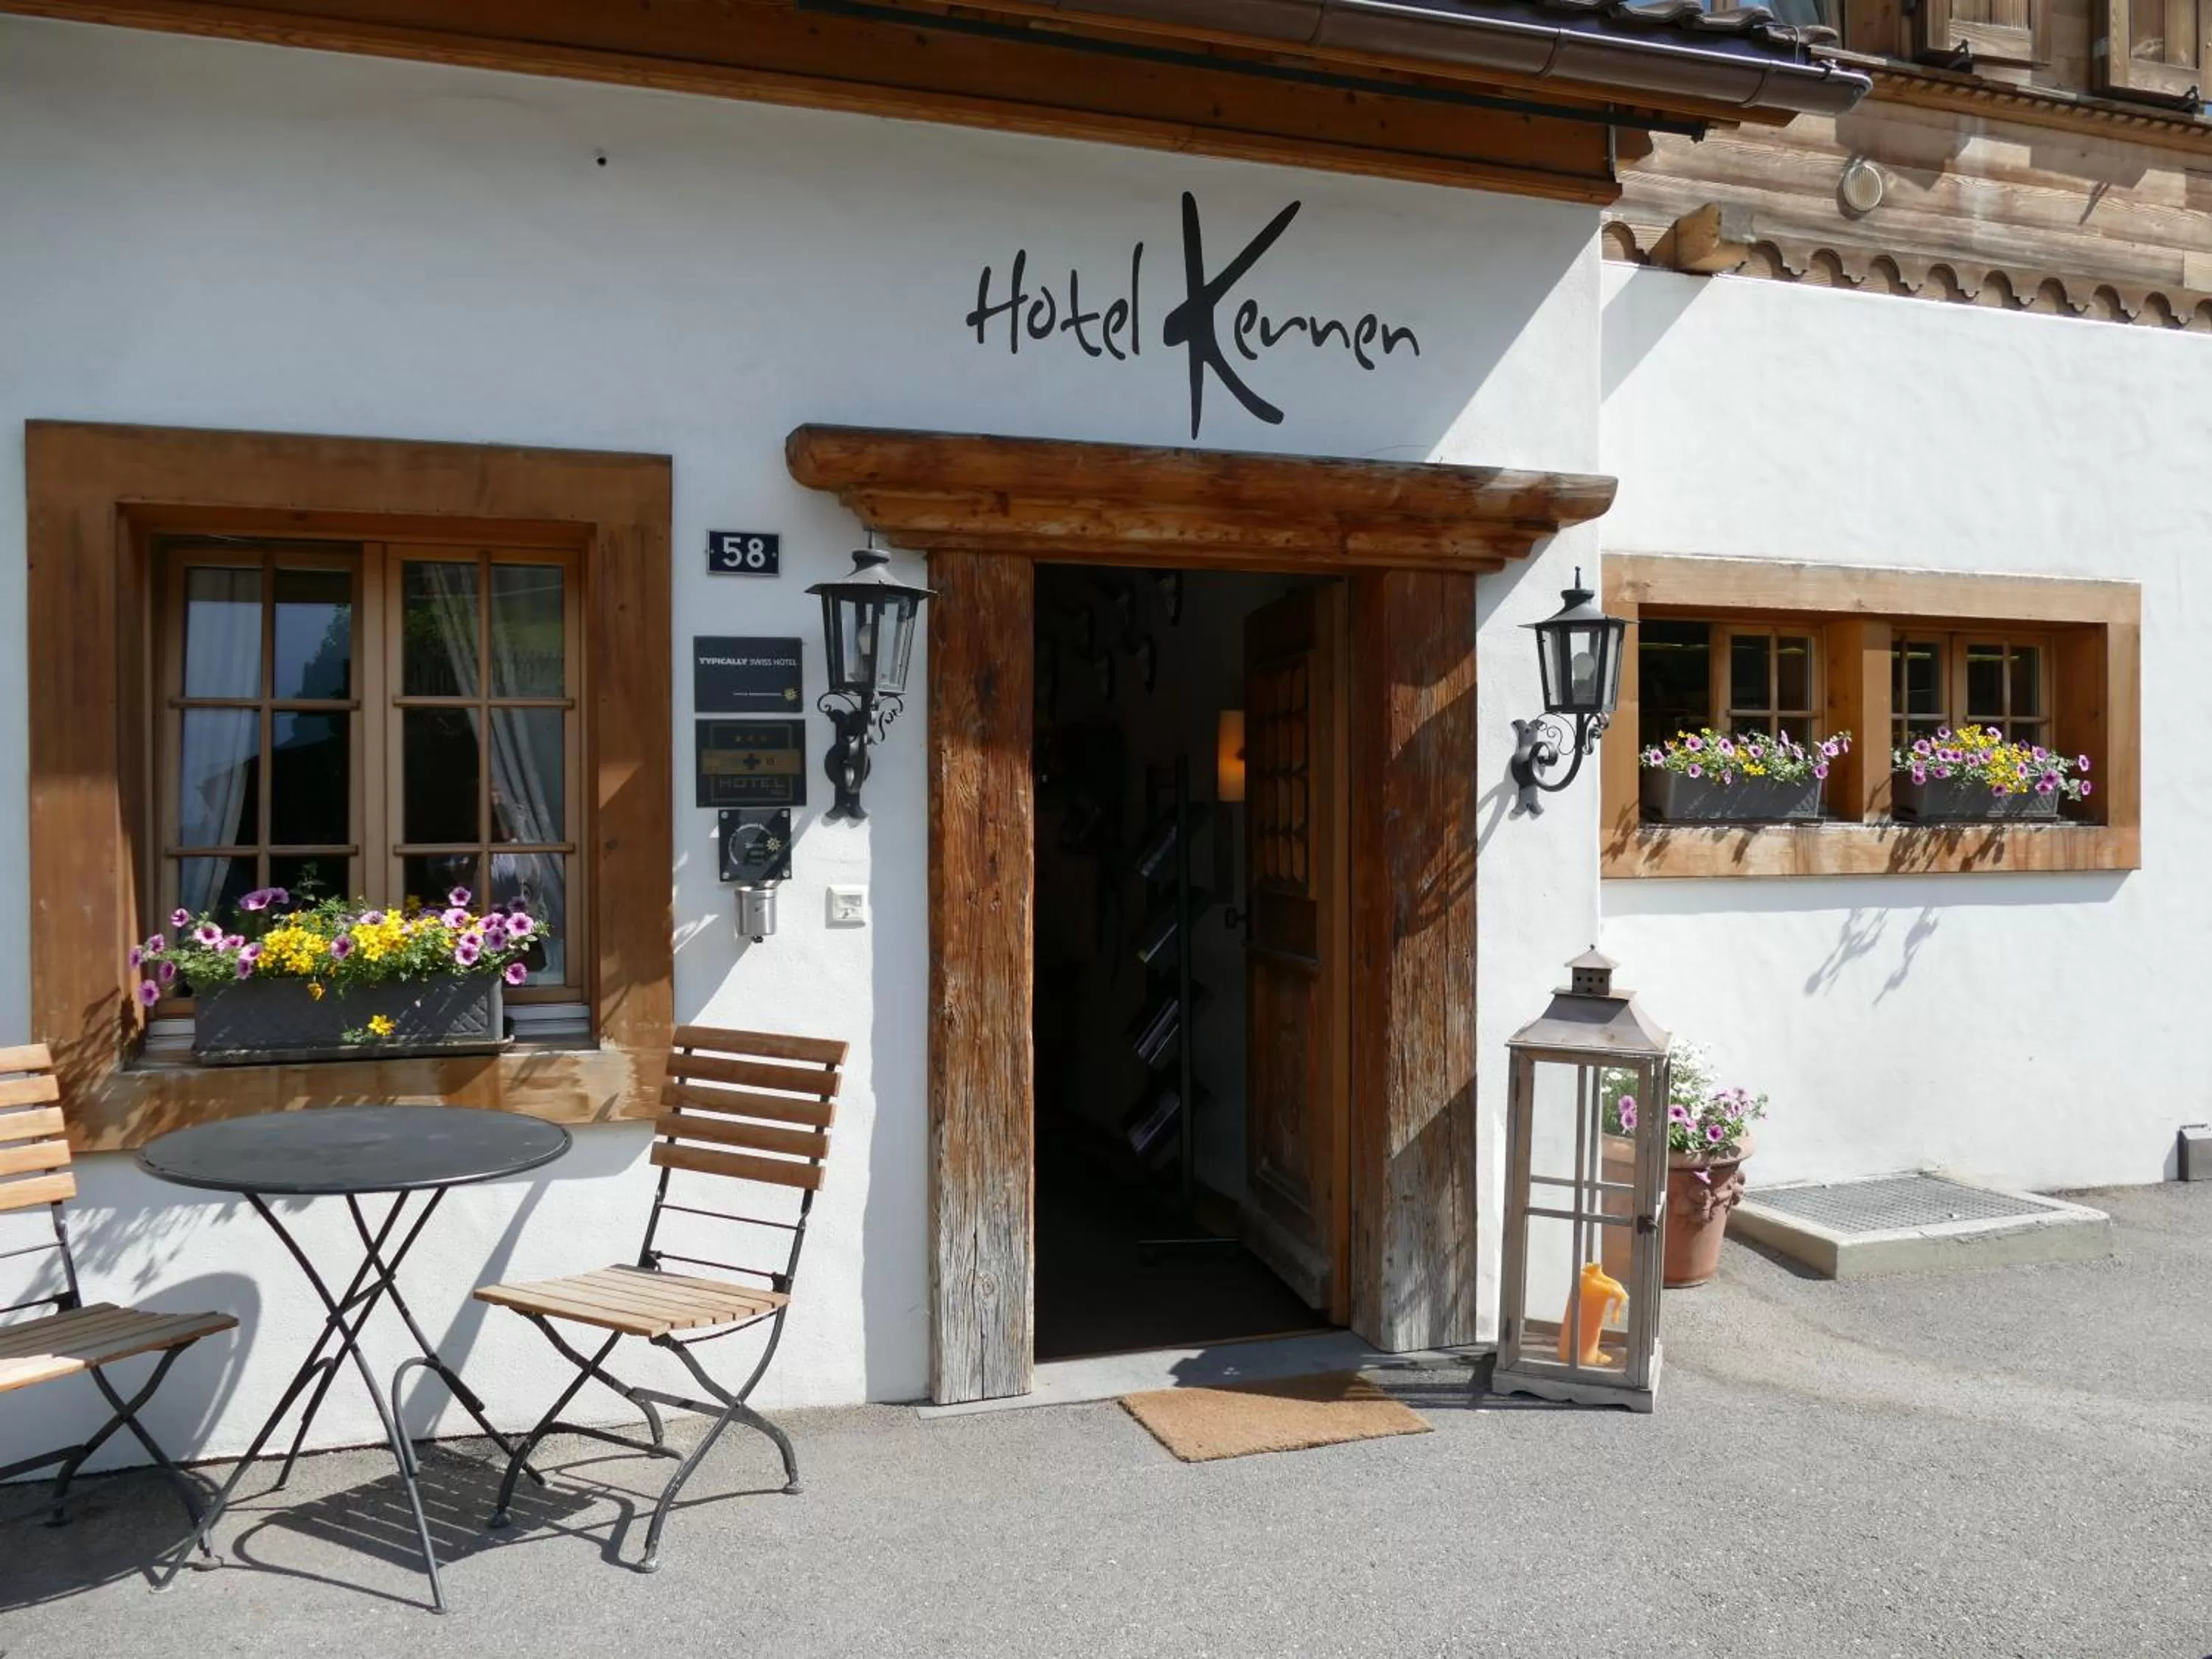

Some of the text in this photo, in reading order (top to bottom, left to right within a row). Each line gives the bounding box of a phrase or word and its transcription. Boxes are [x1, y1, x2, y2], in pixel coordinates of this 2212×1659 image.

[966, 191, 1419, 440] Hotel Kernen
[723, 536, 765, 568] 58
[698, 657, 748, 665] TYPICALLY
[773, 658, 797, 667] HOTEL
